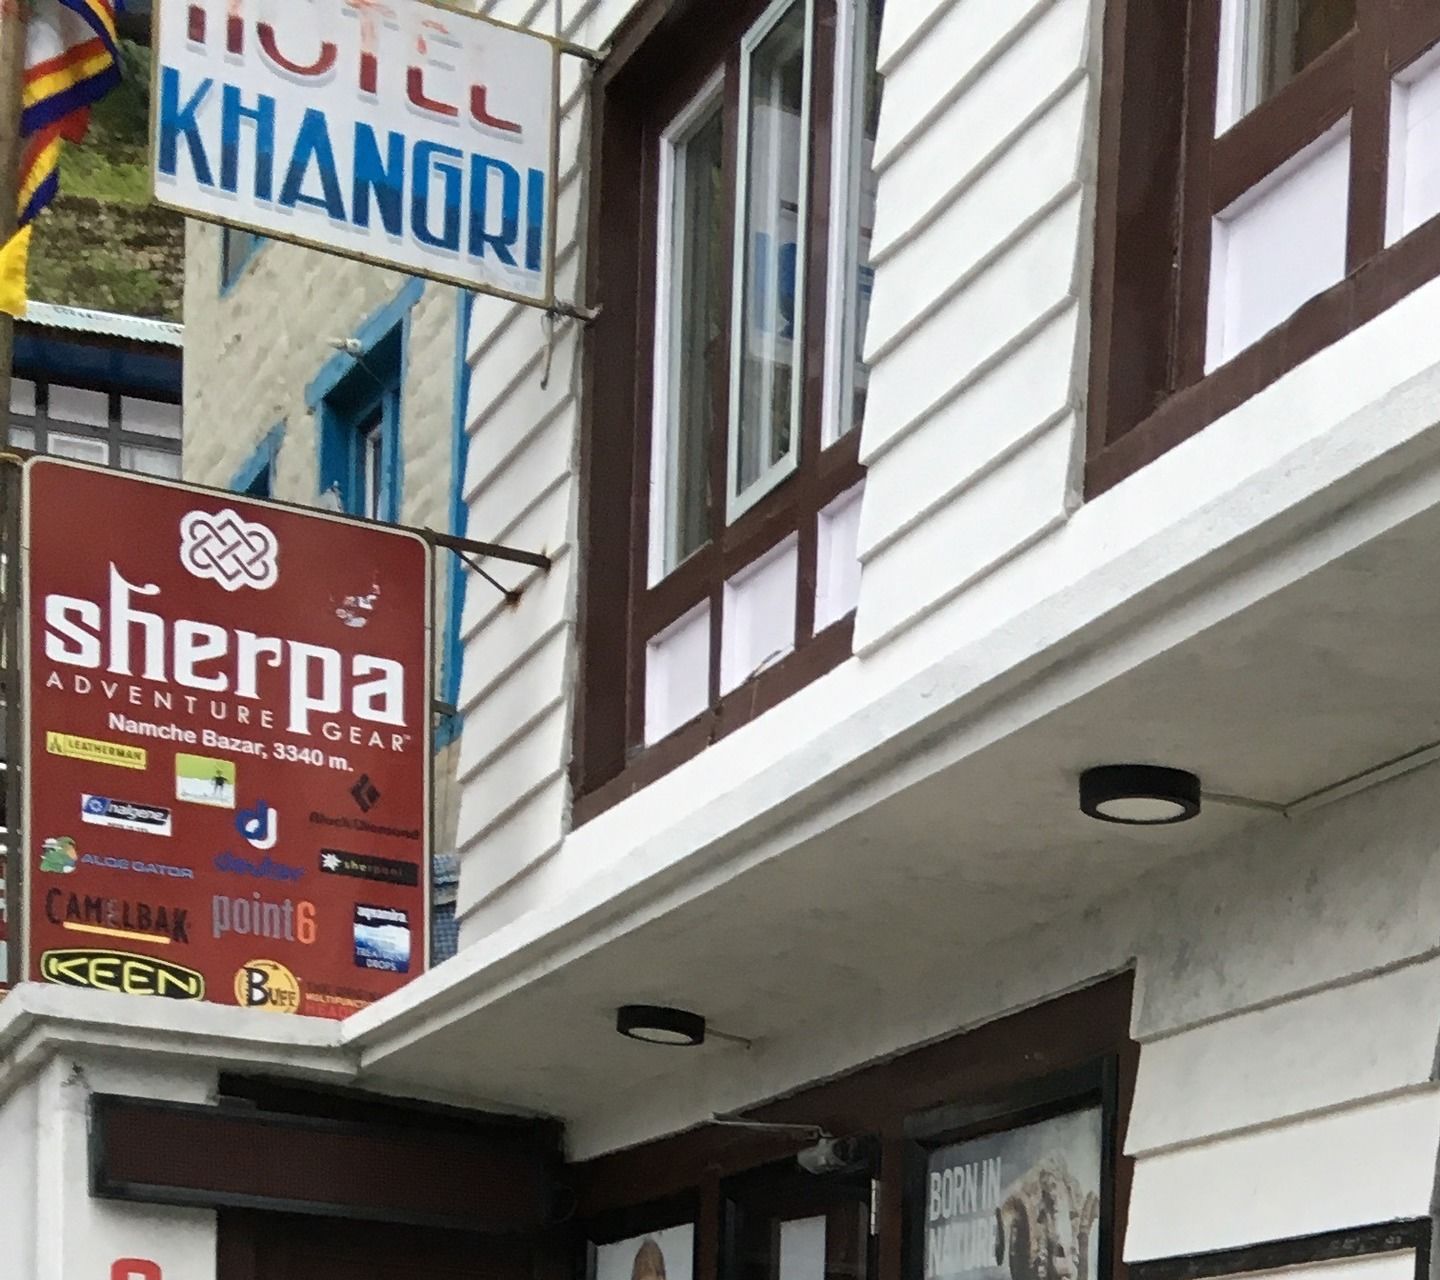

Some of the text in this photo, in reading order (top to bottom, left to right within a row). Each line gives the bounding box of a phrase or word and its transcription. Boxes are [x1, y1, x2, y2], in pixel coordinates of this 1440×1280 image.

[158, 66, 547, 273] KHANGRI
[45, 561, 407, 738] sherpa
[46, 670, 406, 753] ADVENTURE GEAR
[67, 739, 143, 762] LEATHERMAN
[108, 711, 355, 772] Namche Bazar, 3340 m.
[108, 799, 165, 820] nalgene
[132, 861, 194, 880] GATOR
[45, 887, 190, 944] CAMELBAK
[49, 956, 199, 996] KEEN
[929, 1156, 1001, 1221] BORN IN
